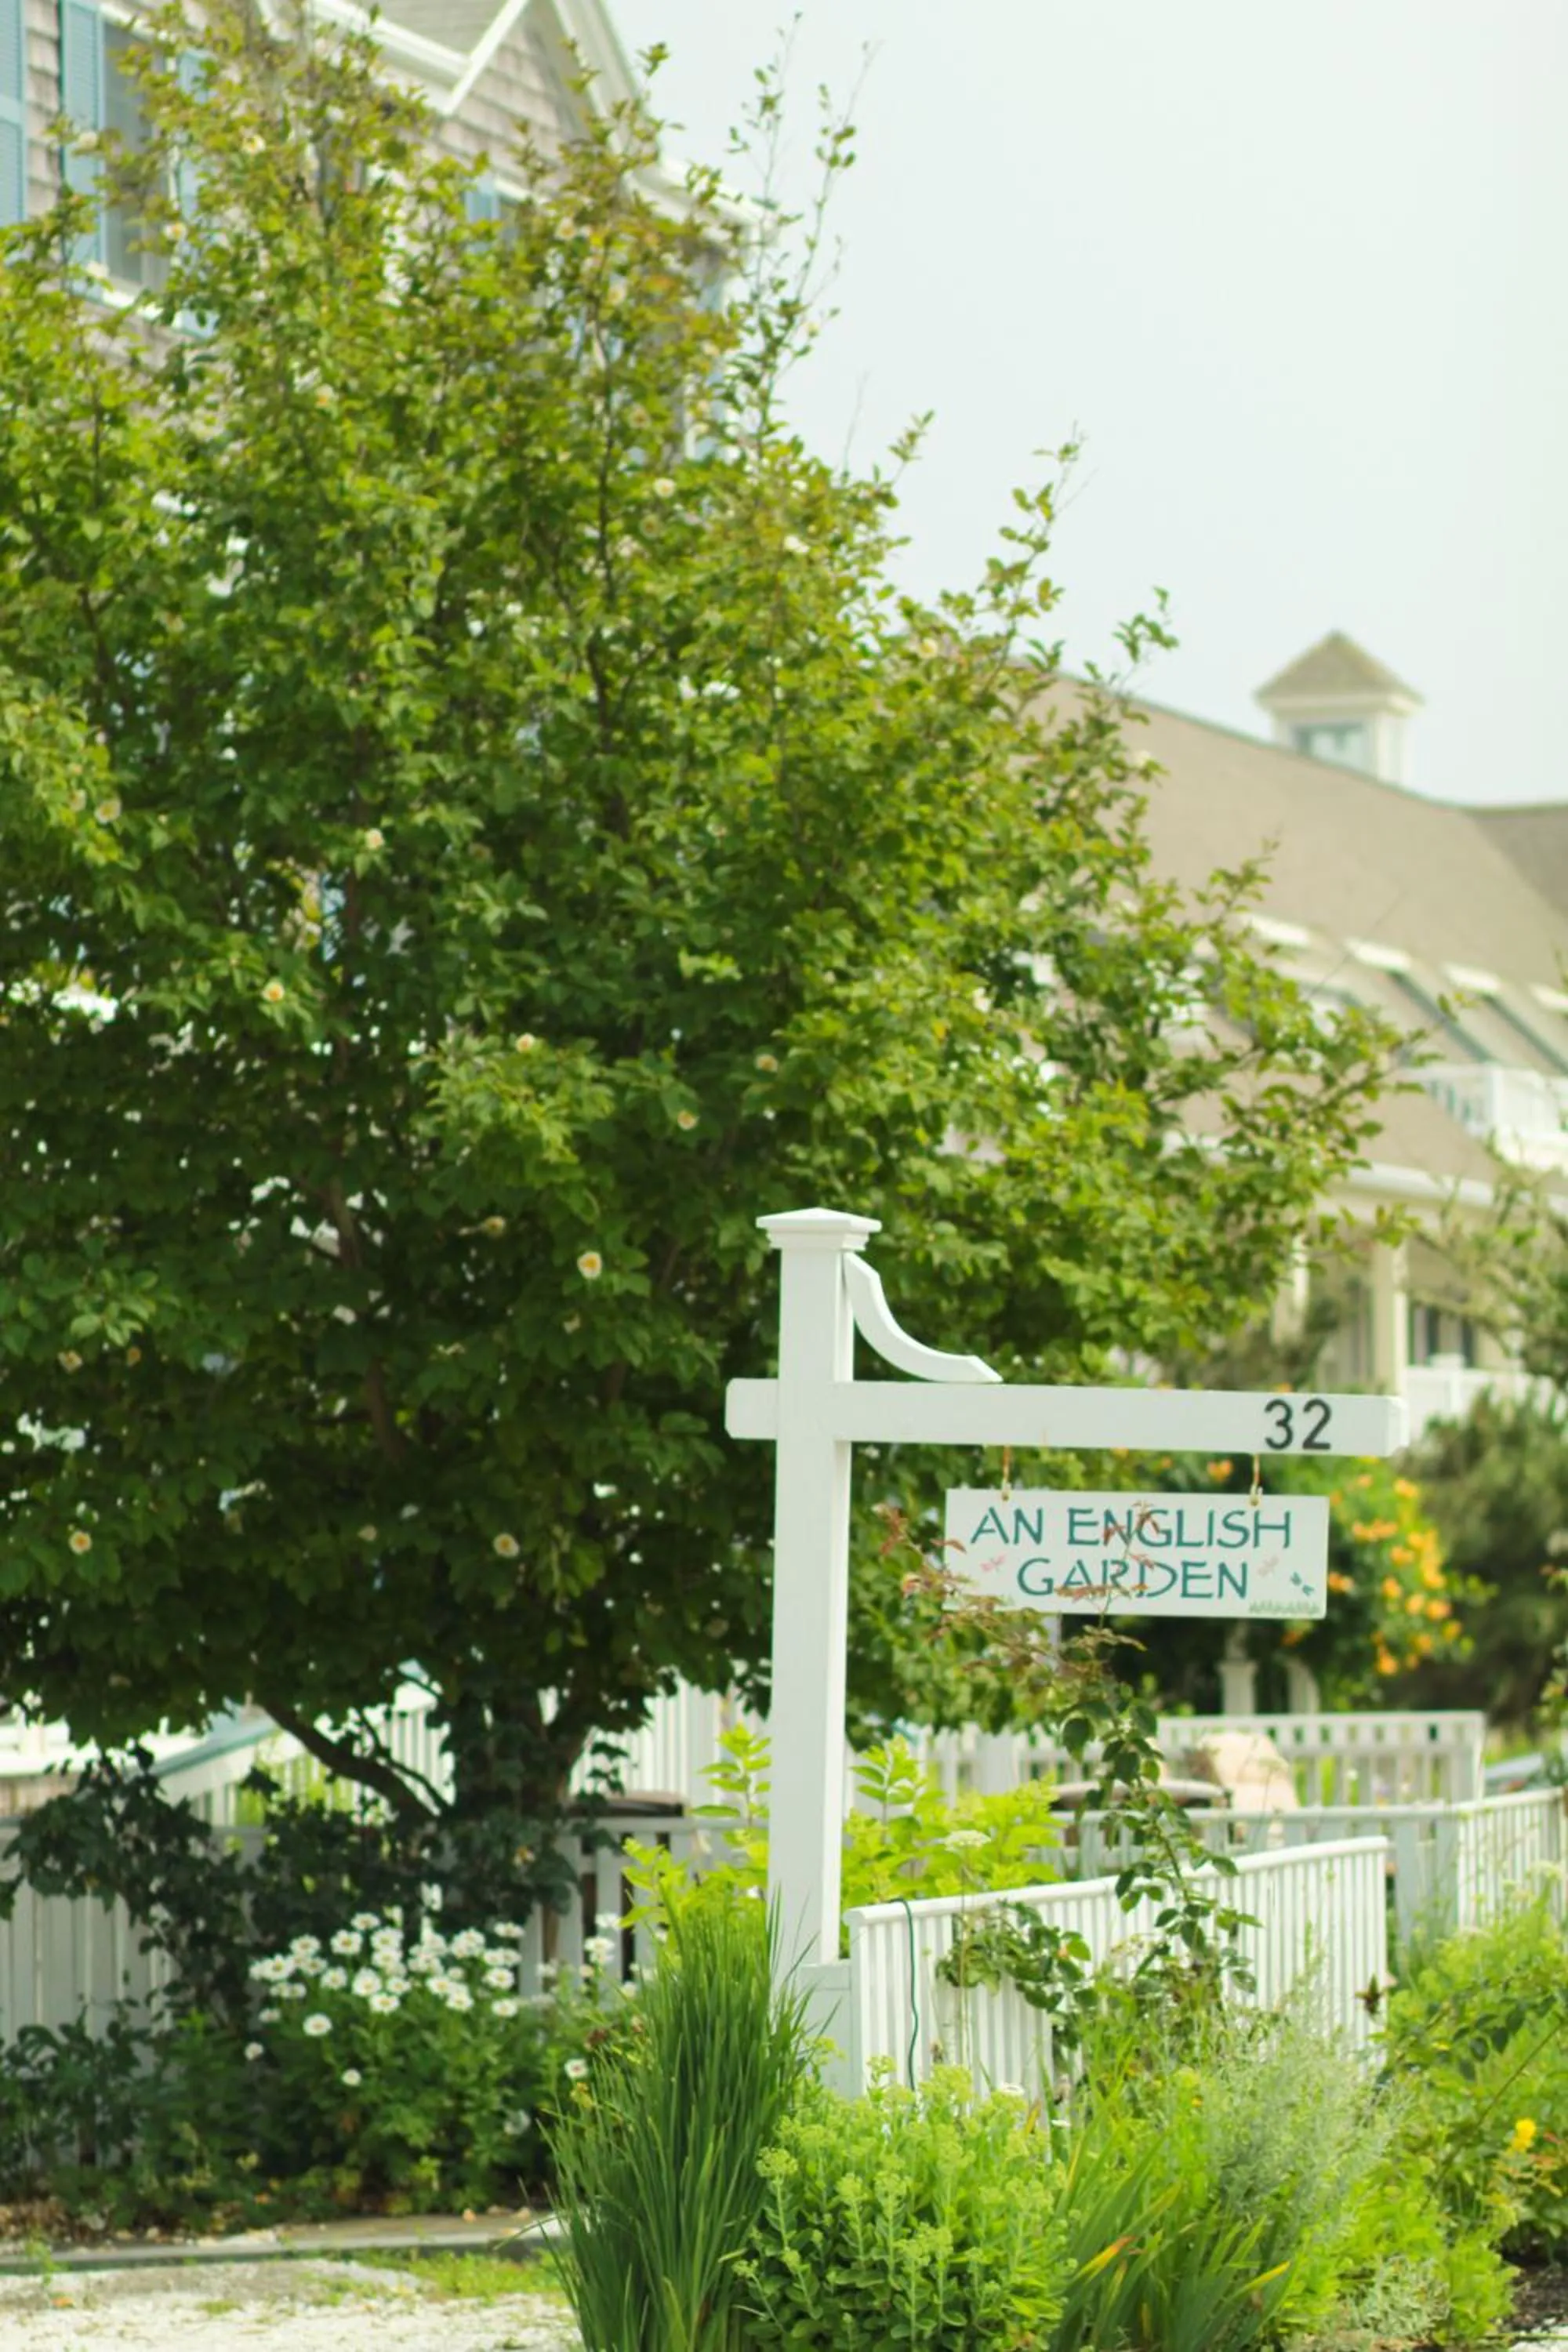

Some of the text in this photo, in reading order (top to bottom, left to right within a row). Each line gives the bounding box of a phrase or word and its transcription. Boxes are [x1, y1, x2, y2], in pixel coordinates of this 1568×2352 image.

[1264, 1399, 1332, 1450] 32
[971, 1506, 1291, 1548] AN ENGLISH
[1017, 1558, 1249, 1599] GARDEN
